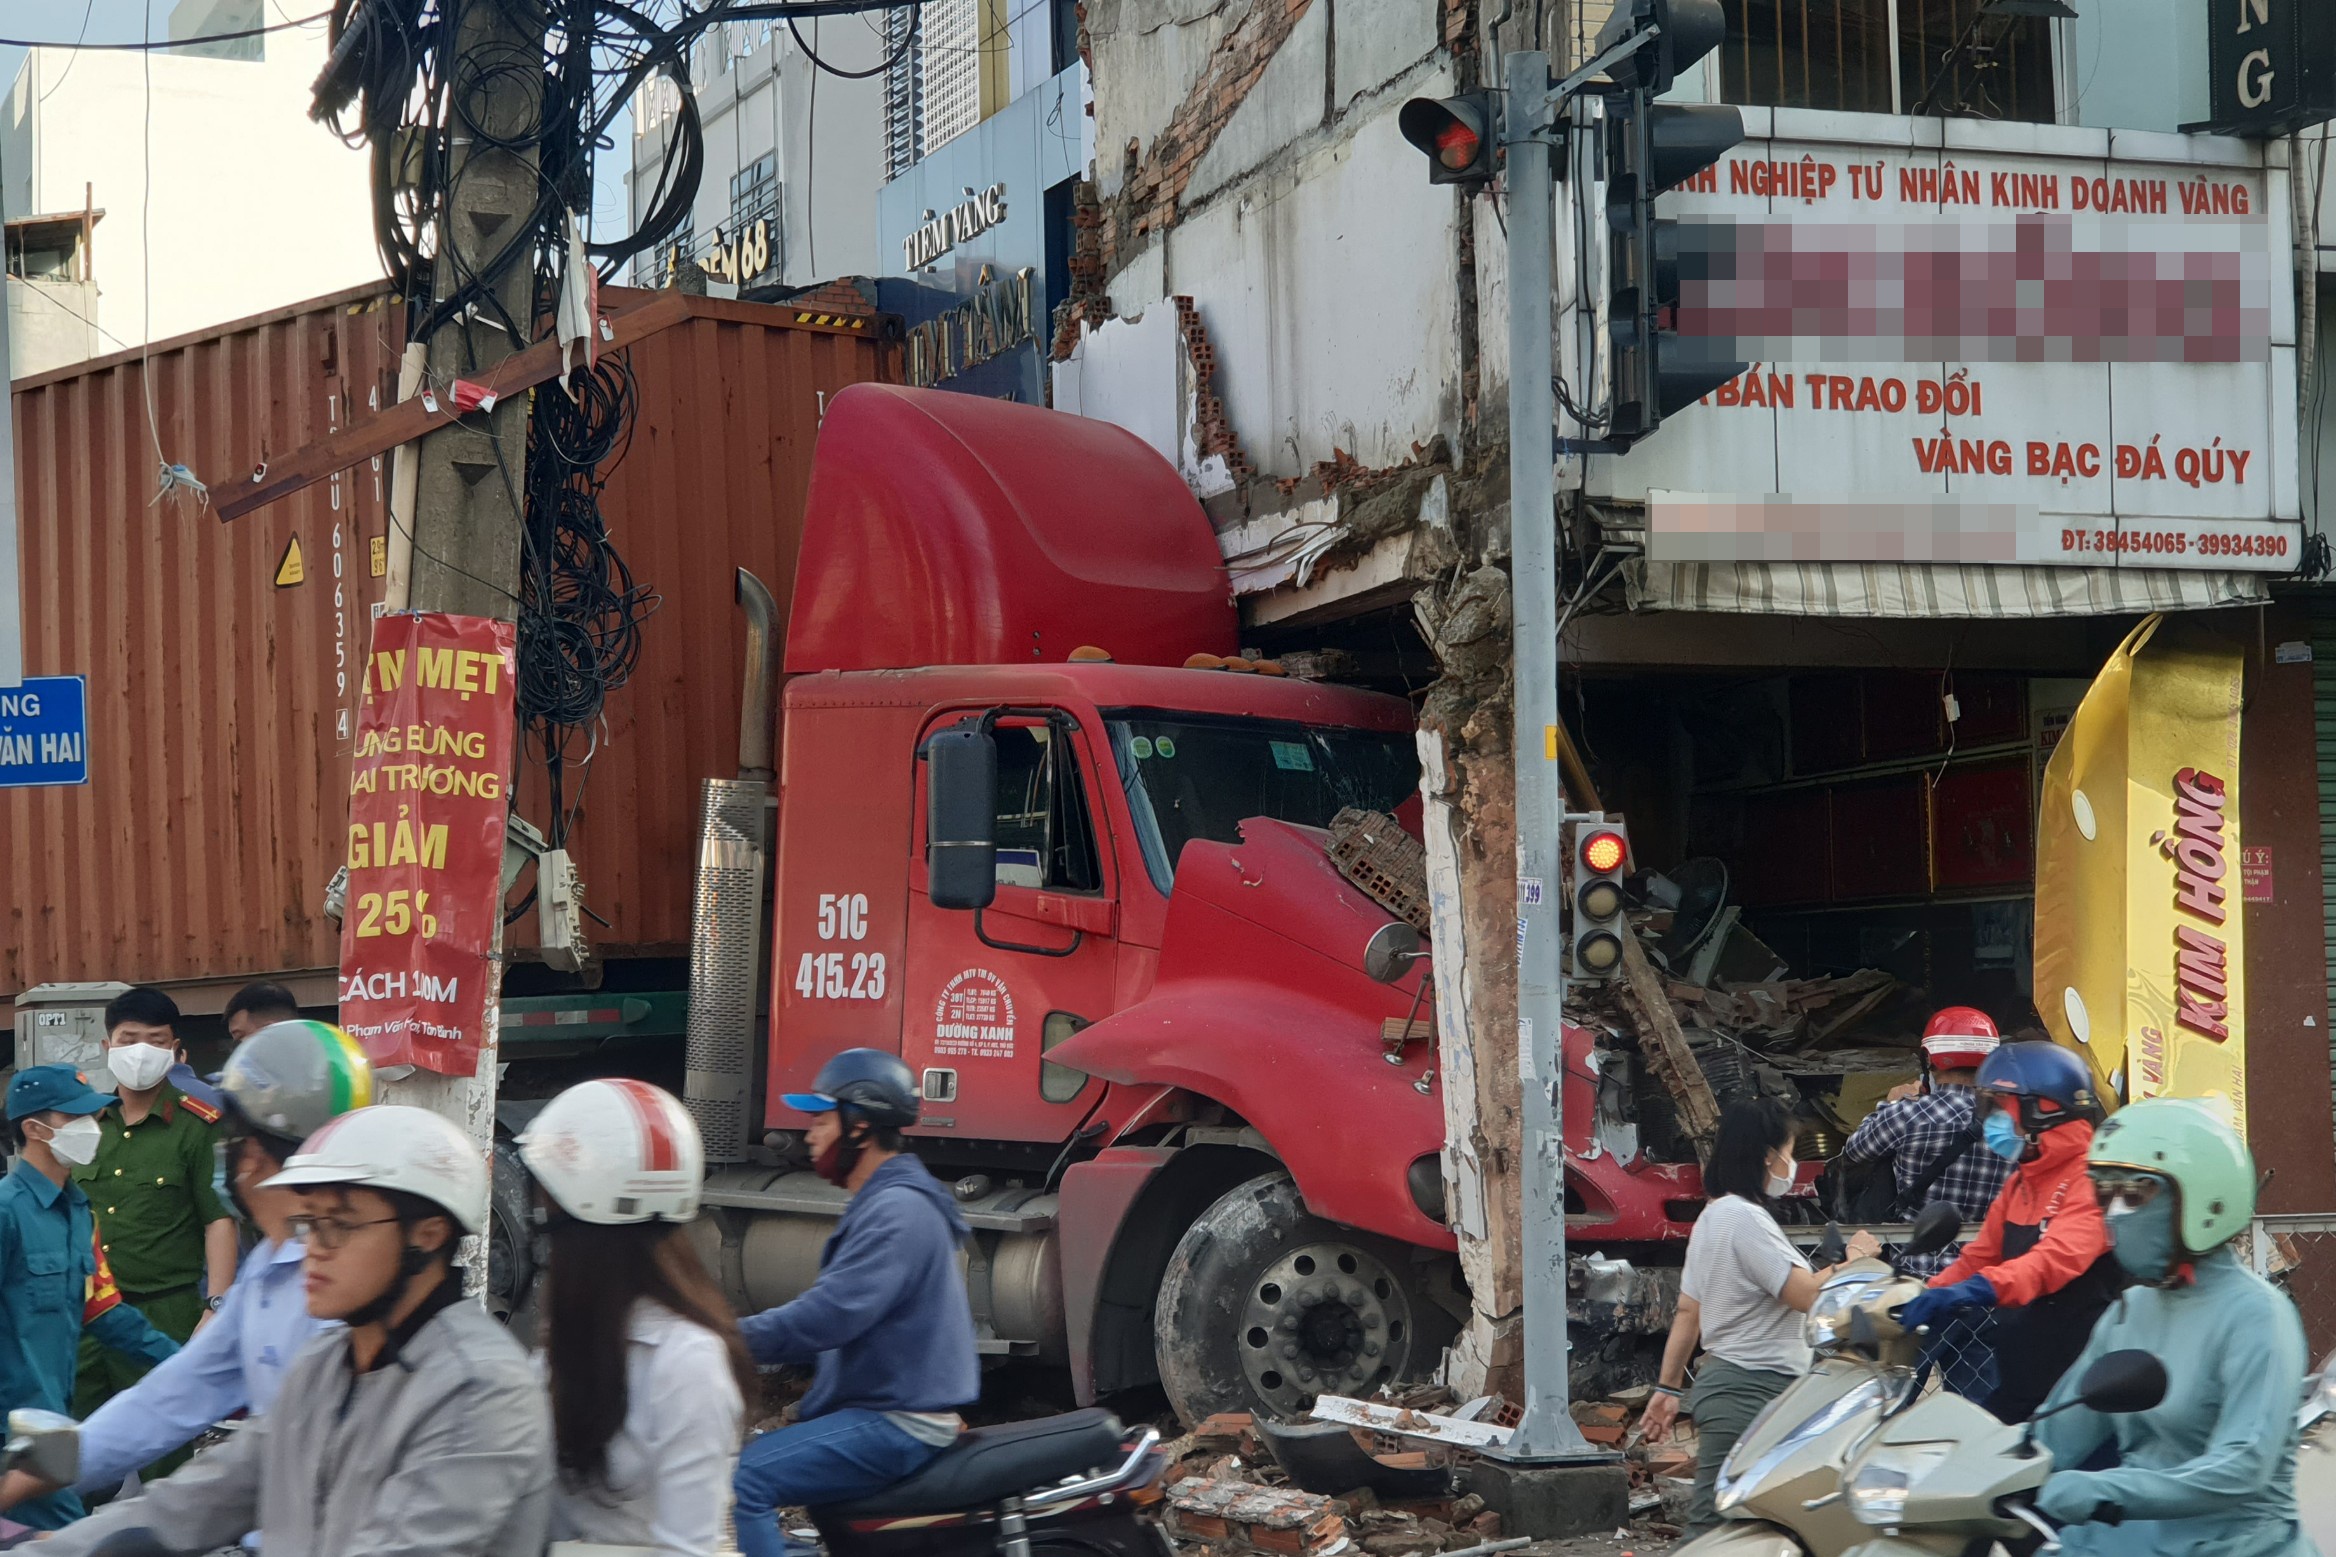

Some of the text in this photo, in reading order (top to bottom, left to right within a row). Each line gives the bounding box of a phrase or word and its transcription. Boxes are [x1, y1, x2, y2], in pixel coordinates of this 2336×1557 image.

[1669, 153, 2249, 214] NH NGHIỆP TƯ NHÂN KINH DOANH VÀNG
[741, 218, 771, 280] 68
[903, 183, 1008, 273] TIỆM VÀNG
[1716, 362, 1982, 416] BÁN TRAO ĐỔI
[1912, 428, 2251, 489] VÀNG BẠC ĐÁ QÚY
[416, 646, 506, 702] MẸT
[40, 731, 82, 764] HAI
[347, 803, 449, 870] GIẢM
[2255, 848, 2269, 864] Ý:
[355, 888, 438, 939] 25%
[818, 893, 868, 940] 51C
[2151, 767, 2229, 1044] KIM HỒNG
[338, 967, 406, 1003] CÁCH
[795, 952, 886, 999] 415.23
[38, 1012, 66, 1026] OPT1
[346, 1023, 382, 1039] Phạm
[980, 1026, 1014, 1041] XANH
[2136, 1025, 2164, 1086] VÀNG
